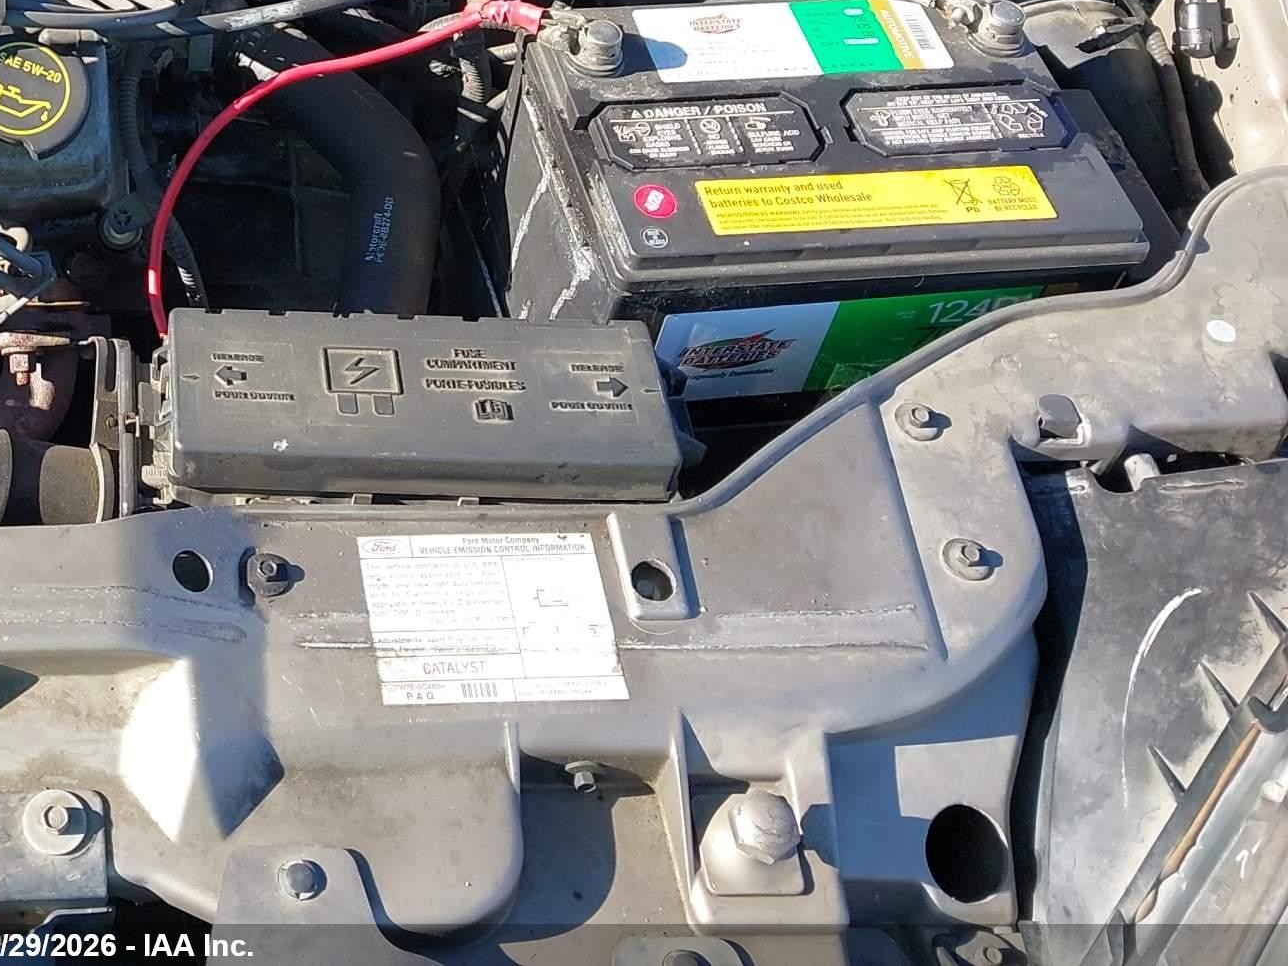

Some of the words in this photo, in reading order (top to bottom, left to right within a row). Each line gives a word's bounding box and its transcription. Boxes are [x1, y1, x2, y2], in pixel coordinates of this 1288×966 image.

[879, 9, 914, 59] AUTOMOTIVE
[22, 61, 62, 84] 5W-20
[645, 107, 701, 119] DANGER
[714, 104, 767, 114] POISON
[704, 184, 741, 197] Return
[744, 183, 791, 197] warranty
[794, 181, 814, 192] and
[818, 180, 843, 191] used
[709, 197, 759, 209] batteries
[761, 197, 772, 206] to
[775, 194, 814, 206] Costco
[815, 191, 872, 203] Wholesale
[988, 198, 1017, 206] BATTERY
[1019, 196, 1037, 204] MUST
[453, 349, 487, 358] FUSE
[679, 338, 797, 357] INTERSTATE
[212, 352, 264, 363] RELEASE
[676, 350, 778, 367] BATTERIES
[426, 359, 517, 371] COMPARTMENT
[570, 364, 624, 373] RELEASE
[371, 539, 397, 552] Ford
[505, 536, 539, 544] Company
[419, 546, 451, 554] VEHICLE
[453, 544, 492, 553] EMISSION
[494, 543, 530, 552] CONTROL
[532, 542, 585, 551] INFORMATION
[423, 660, 486, 674] CATALYST
